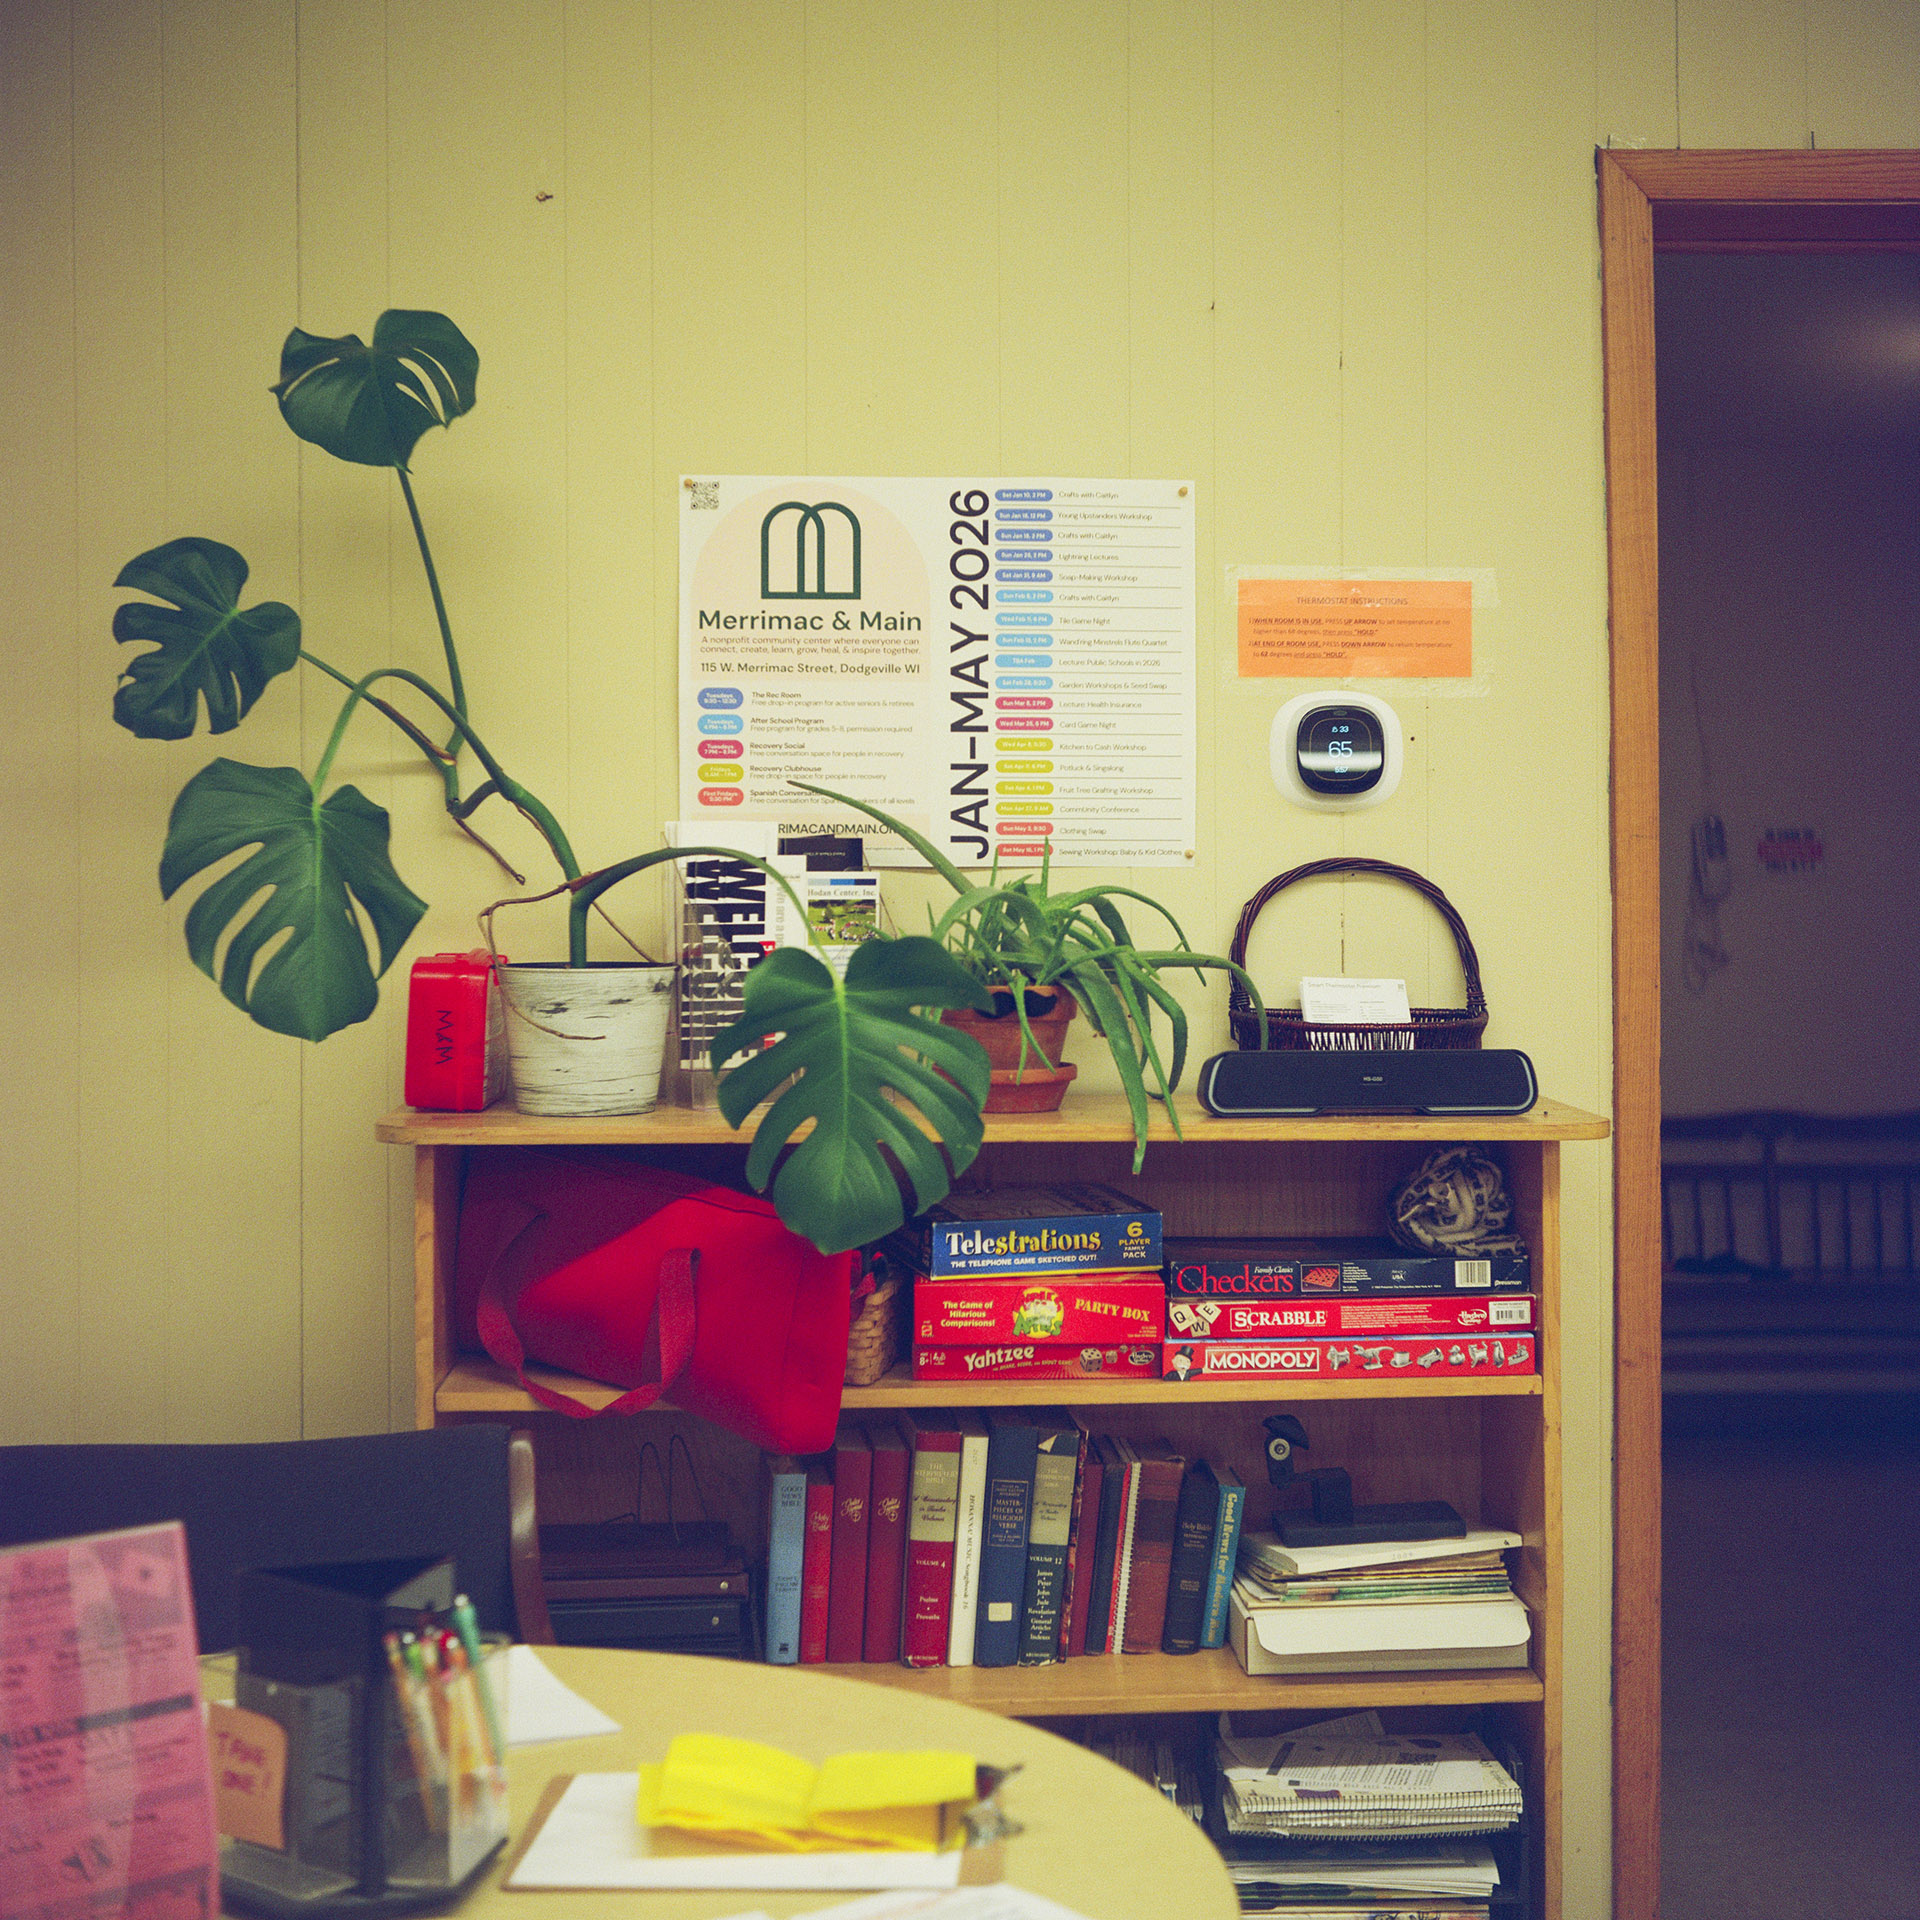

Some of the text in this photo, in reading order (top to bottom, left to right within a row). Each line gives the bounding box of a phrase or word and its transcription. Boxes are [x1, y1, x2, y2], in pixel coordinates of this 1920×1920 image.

[949, 490, 989, 610] 2026
[1297, 597, 1408, 605] THERMOSTAT INSTRUCTIONS
[699, 610, 921, 631] Merrimac & Main
[710, 636, 749, 645] nonprofit
[752, 637, 800, 645] community
[834, 637, 860, 645] where
[852, 647, 881, 655] inspire
[701, 663, 920, 676] 115 W. Merrimac Street, Dodgeville WI
[1113, 744, 1147, 752] Workshop
[1329, 741, 1352, 758] 65
[1120, 787, 1153, 795] Workshop
[1120, 849, 1136, 857] Baby
[1127, 1221, 1144, 1238] 6
[946, 1229, 1101, 1256] Telestrations
[1119, 1238, 1150, 1246] PLAYER
[1123, 1251, 1146, 1259] PACK
[968, 1258, 1012, 1268] TELEPHONE
[1014, 1256, 1036, 1265] GAME
[1037, 1255, 1076, 1264] SKETCHED
[1254, 1266, 1273, 1275] Family
[1177, 1264, 1294, 1294] Checkers
[943, 1300, 993, 1309] The Game of
[1074, 1298, 1150, 1322] PARTY BOX
[1203, 1305, 1214, 1316] E
[949, 1310, 986, 1318] Hilarious
[1173, 1311, 1186, 1323] Q
[1234, 1310, 1326, 1328] SCRABBLE
[941, 1318, 995, 1328] Comparisons!
[1192, 1321, 1206, 1332] W
[920, 1357, 929, 1366] 8+
[964, 1346, 1035, 1372] Yahtzee
[1210, 1351, 1316, 1370] MONOPOLY
[1225, 1493, 1238, 1523] Good
[1219, 1523, 1234, 1554] News
[1218, 1554, 1229, 1573] for
